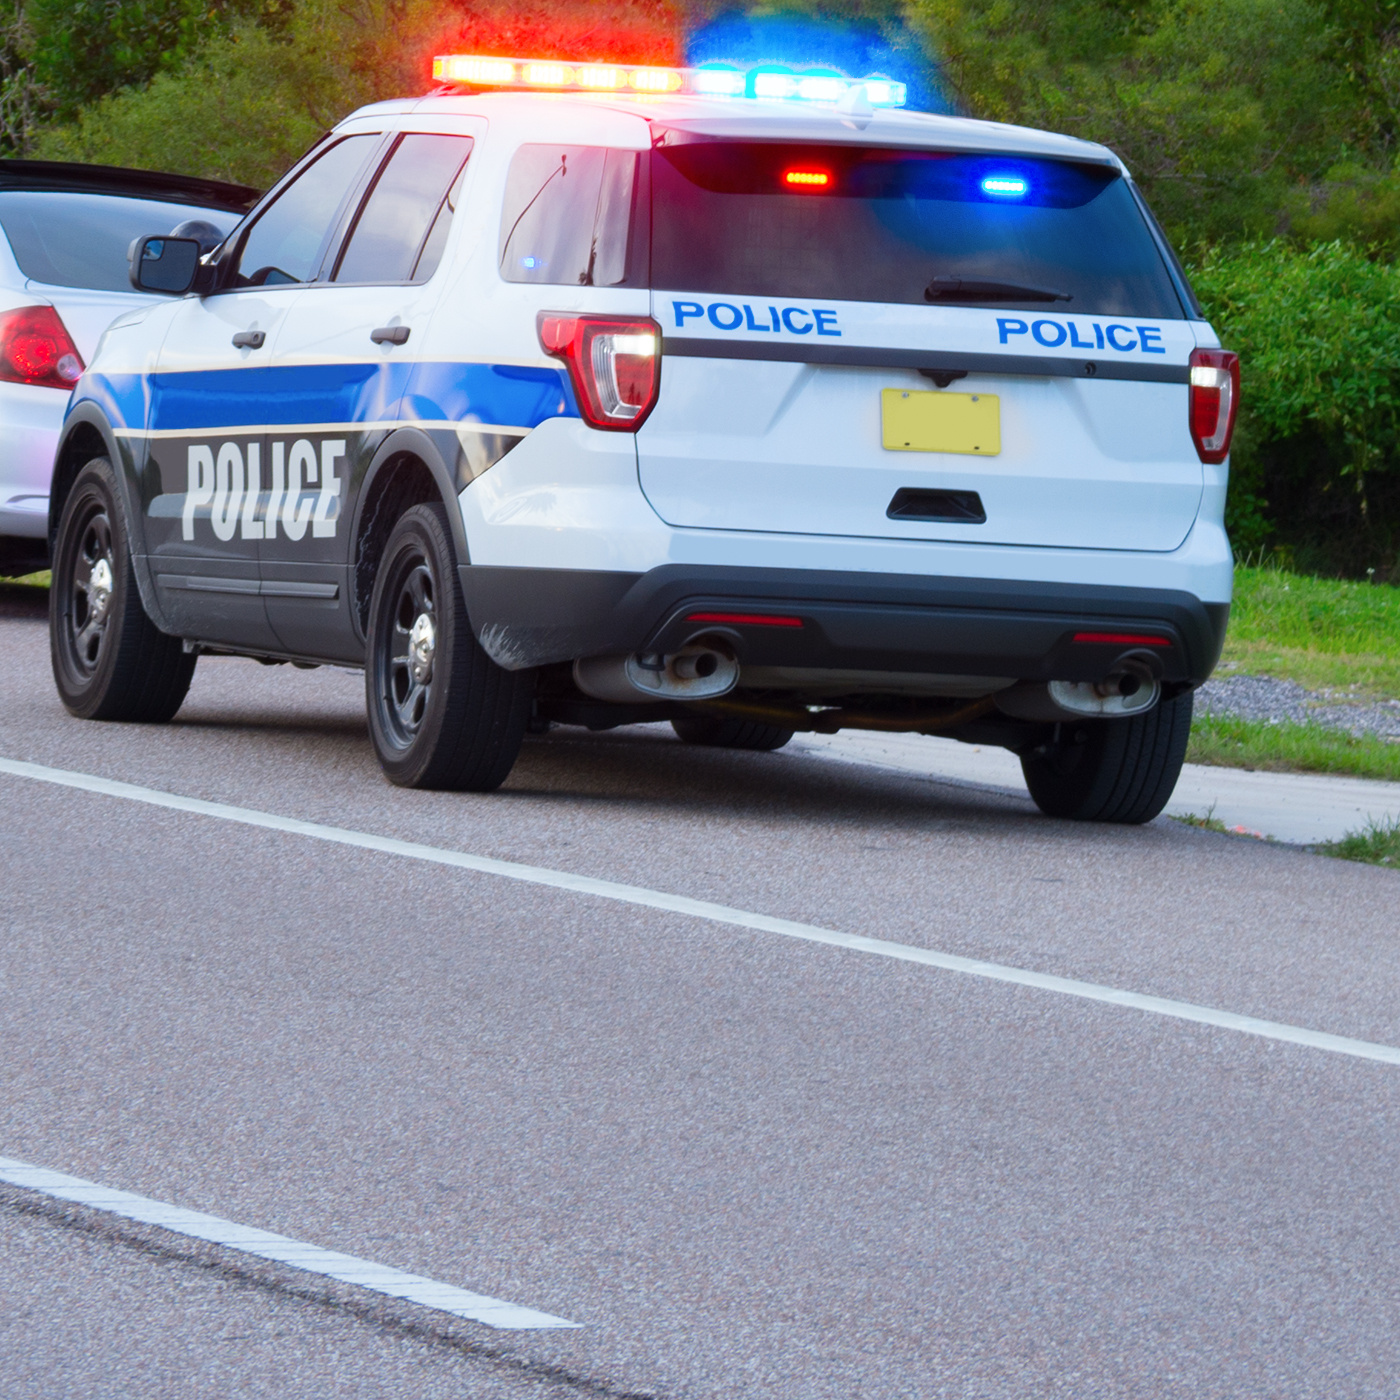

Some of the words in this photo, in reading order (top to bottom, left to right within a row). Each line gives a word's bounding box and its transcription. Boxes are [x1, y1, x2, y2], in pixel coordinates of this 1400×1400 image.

[671, 300, 843, 337] POLICE
[996, 317, 1166, 354] POLICE
[182, 439, 347, 542] POLICE
